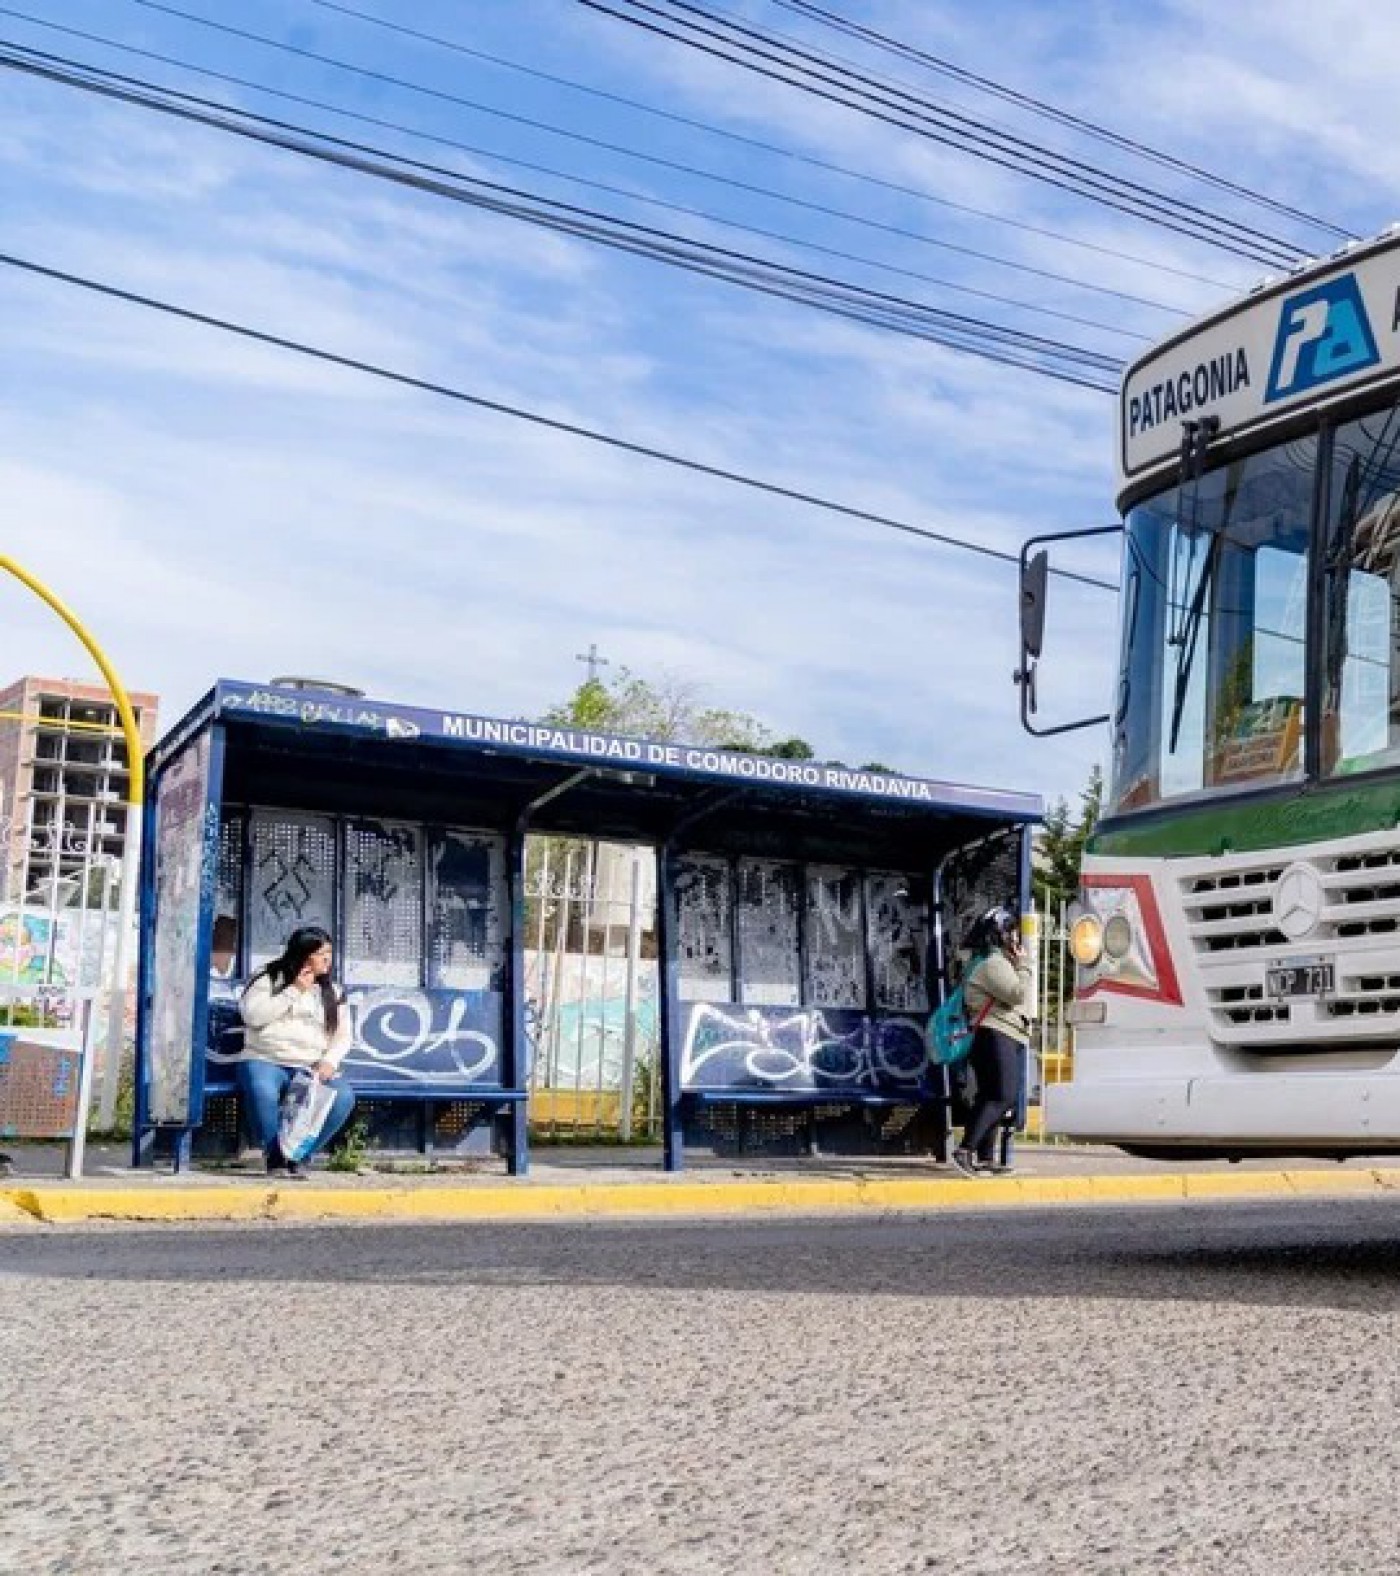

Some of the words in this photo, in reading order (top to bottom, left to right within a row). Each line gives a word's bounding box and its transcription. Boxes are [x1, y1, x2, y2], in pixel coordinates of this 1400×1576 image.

[1129, 347, 1250, 437] PATAGONIA
[442, 715, 641, 760] MUNICIPALIDAD
[647, 745, 680, 767] DE
[686, 750, 820, 785] COMODORO
[825, 770, 932, 800] RIVADAVIA
